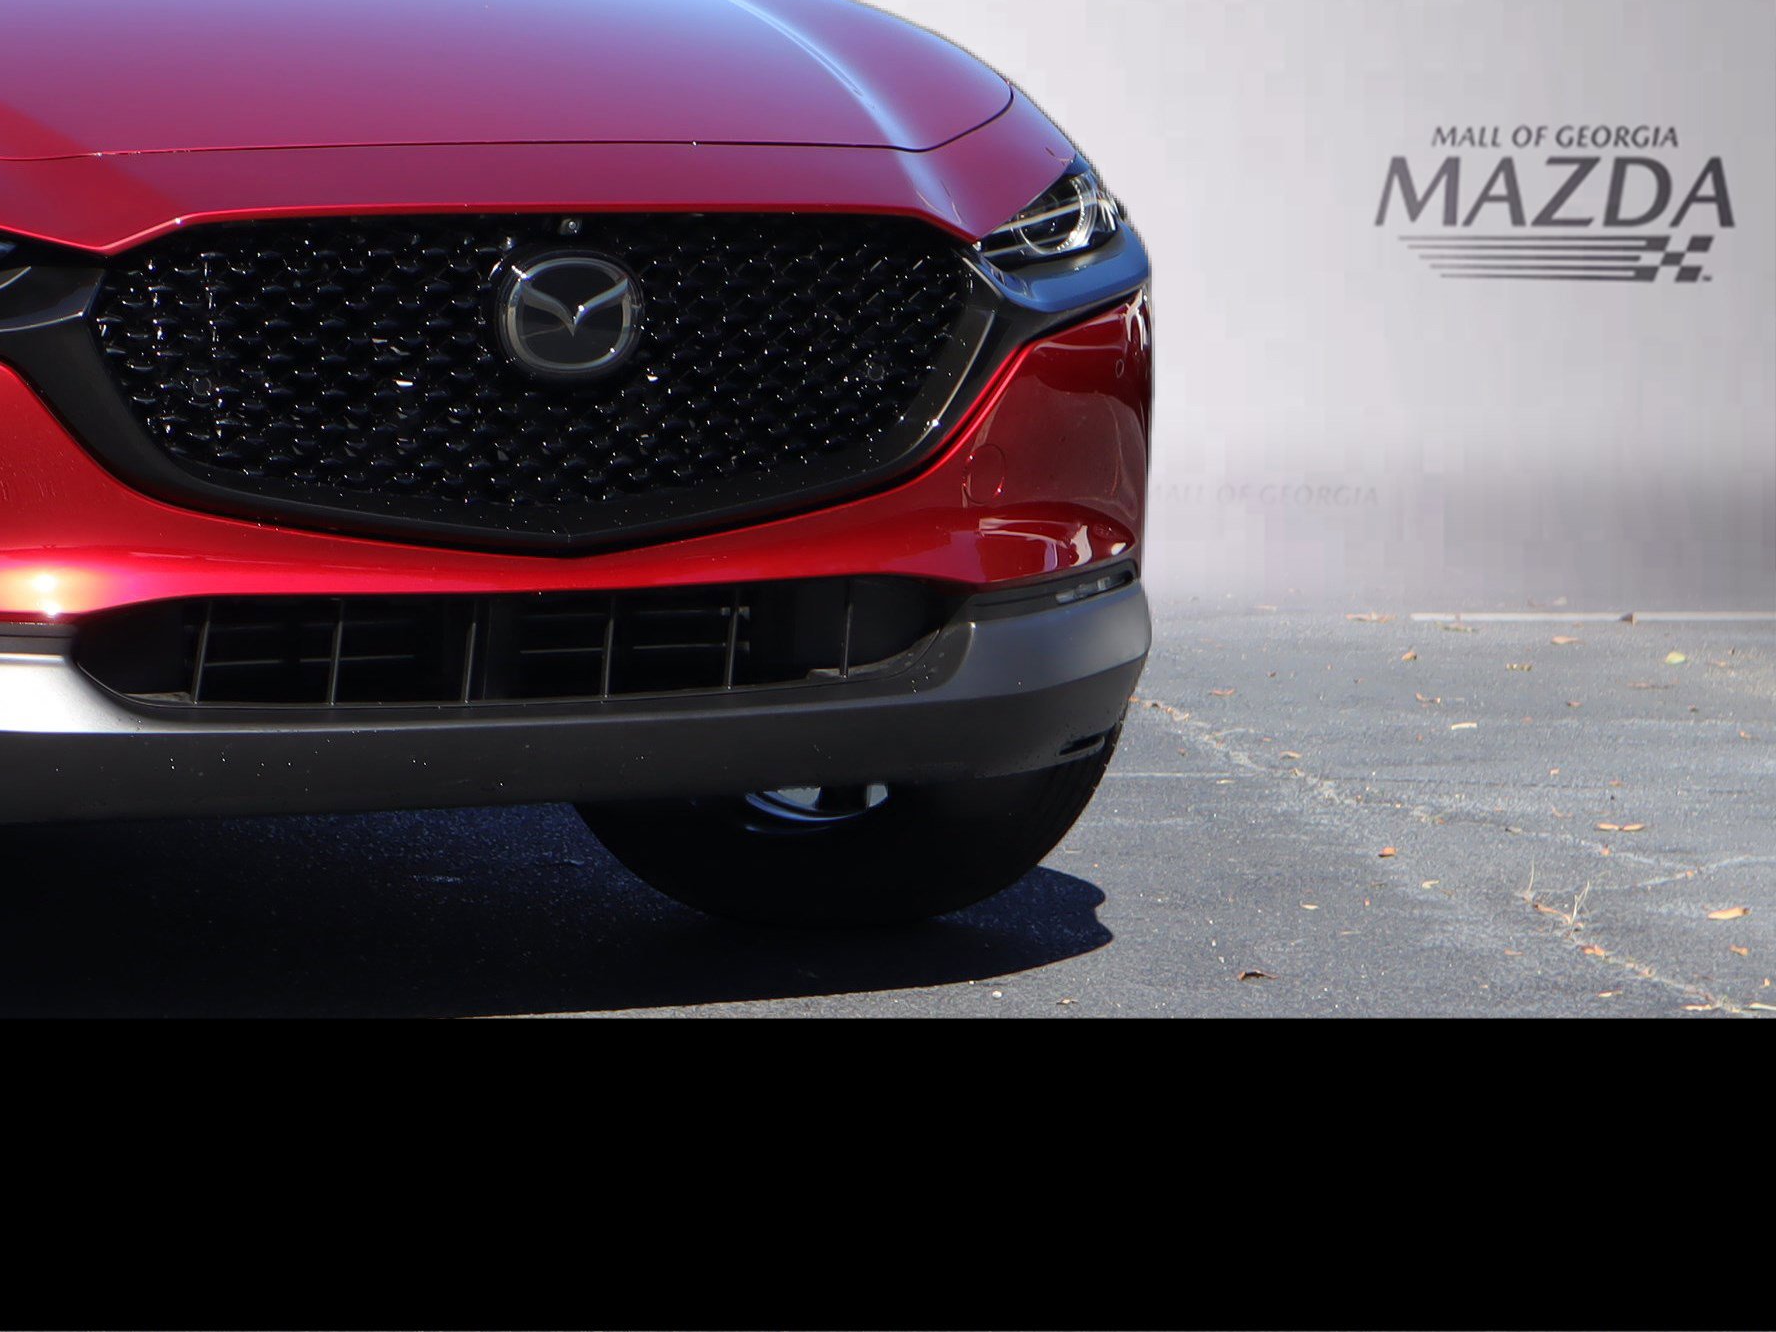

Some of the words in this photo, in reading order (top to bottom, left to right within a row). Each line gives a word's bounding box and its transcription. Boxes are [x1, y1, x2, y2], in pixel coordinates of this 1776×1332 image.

[1434, 126, 1500, 147] MALL
[1512, 125, 1547, 148] OF
[1555, 125, 1678, 148] GEORGIA
[1375, 156, 1735, 228] MAZDA
